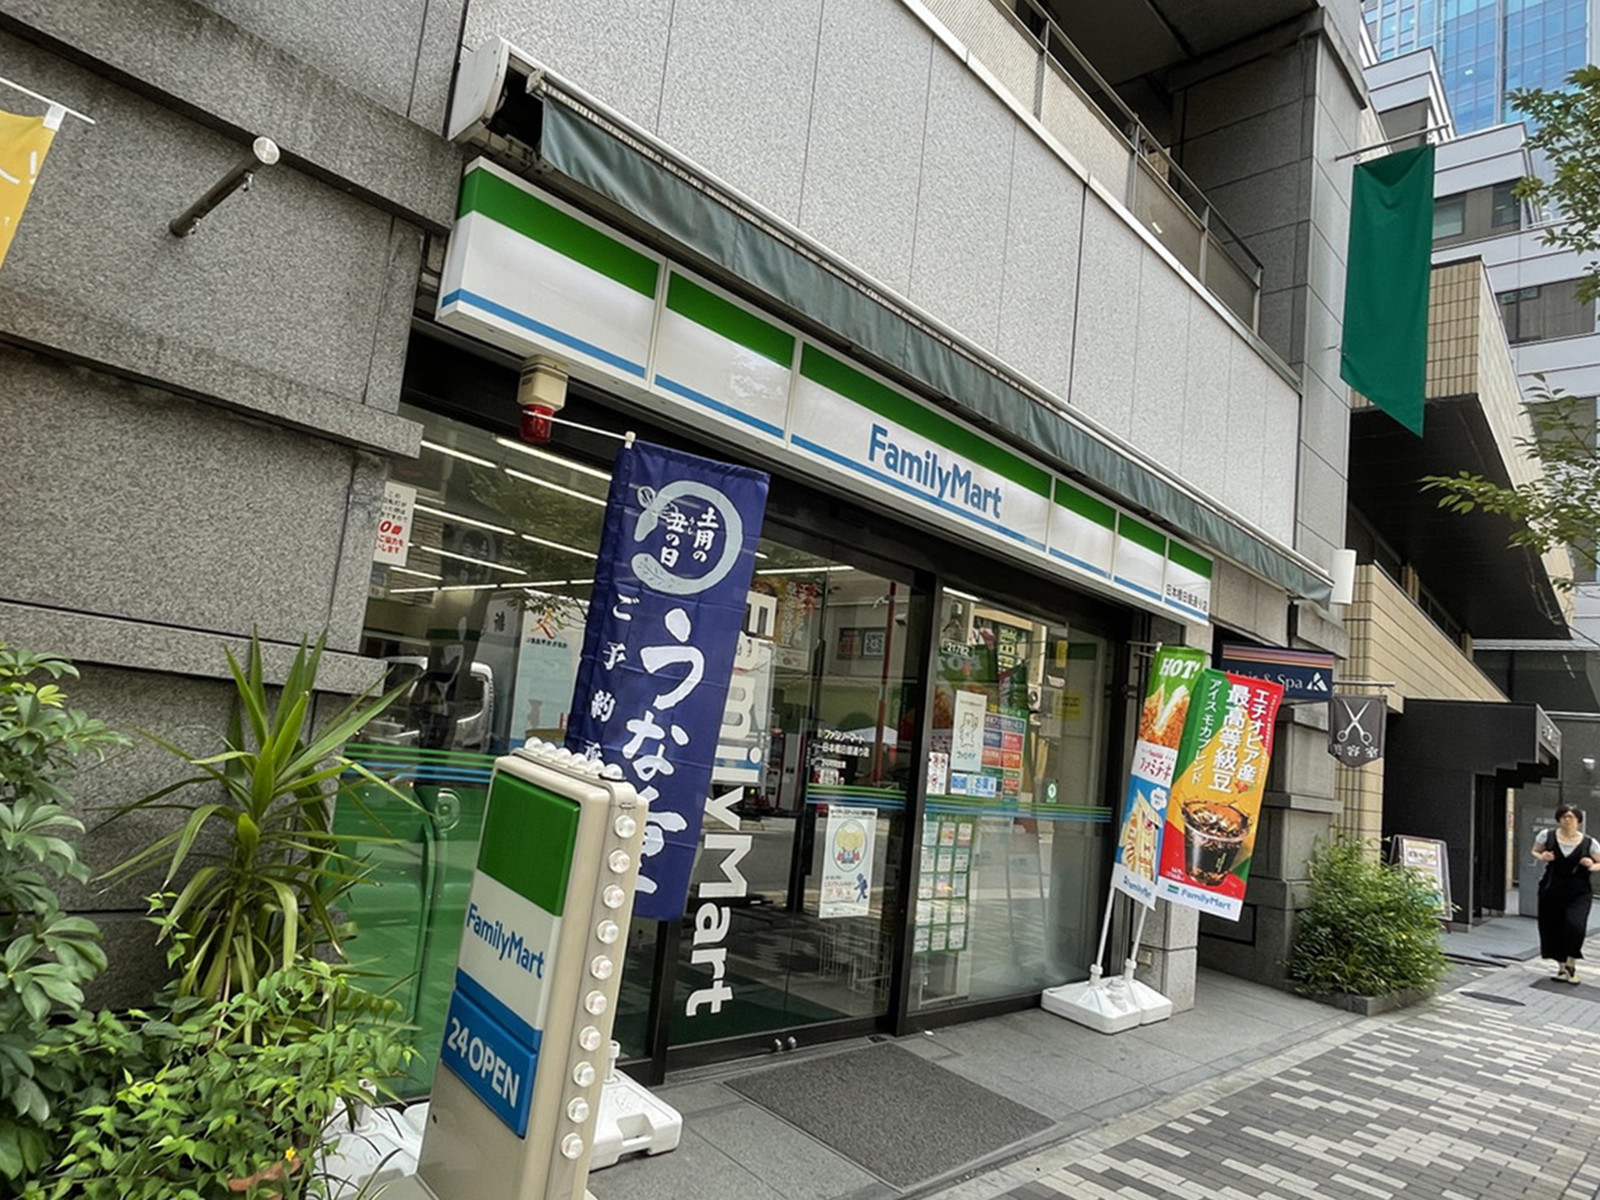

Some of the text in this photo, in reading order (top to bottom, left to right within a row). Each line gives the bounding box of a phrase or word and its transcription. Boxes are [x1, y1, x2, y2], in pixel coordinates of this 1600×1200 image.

[868, 423, 1002, 519] FamilyMart
[660, 512, 689, 568] 丑の日
[692, 506, 719, 562] 土用の
[1159, 657, 1201, 680] HOT!
[1277, 673, 1303, 691] Spa
[1208, 683, 1251, 794] 最高等級豆
[1236, 688, 1270, 784] エチオピア産
[1181, 888, 1232, 911] FamilyMart
[466, 903, 545, 980] FamilyMart
